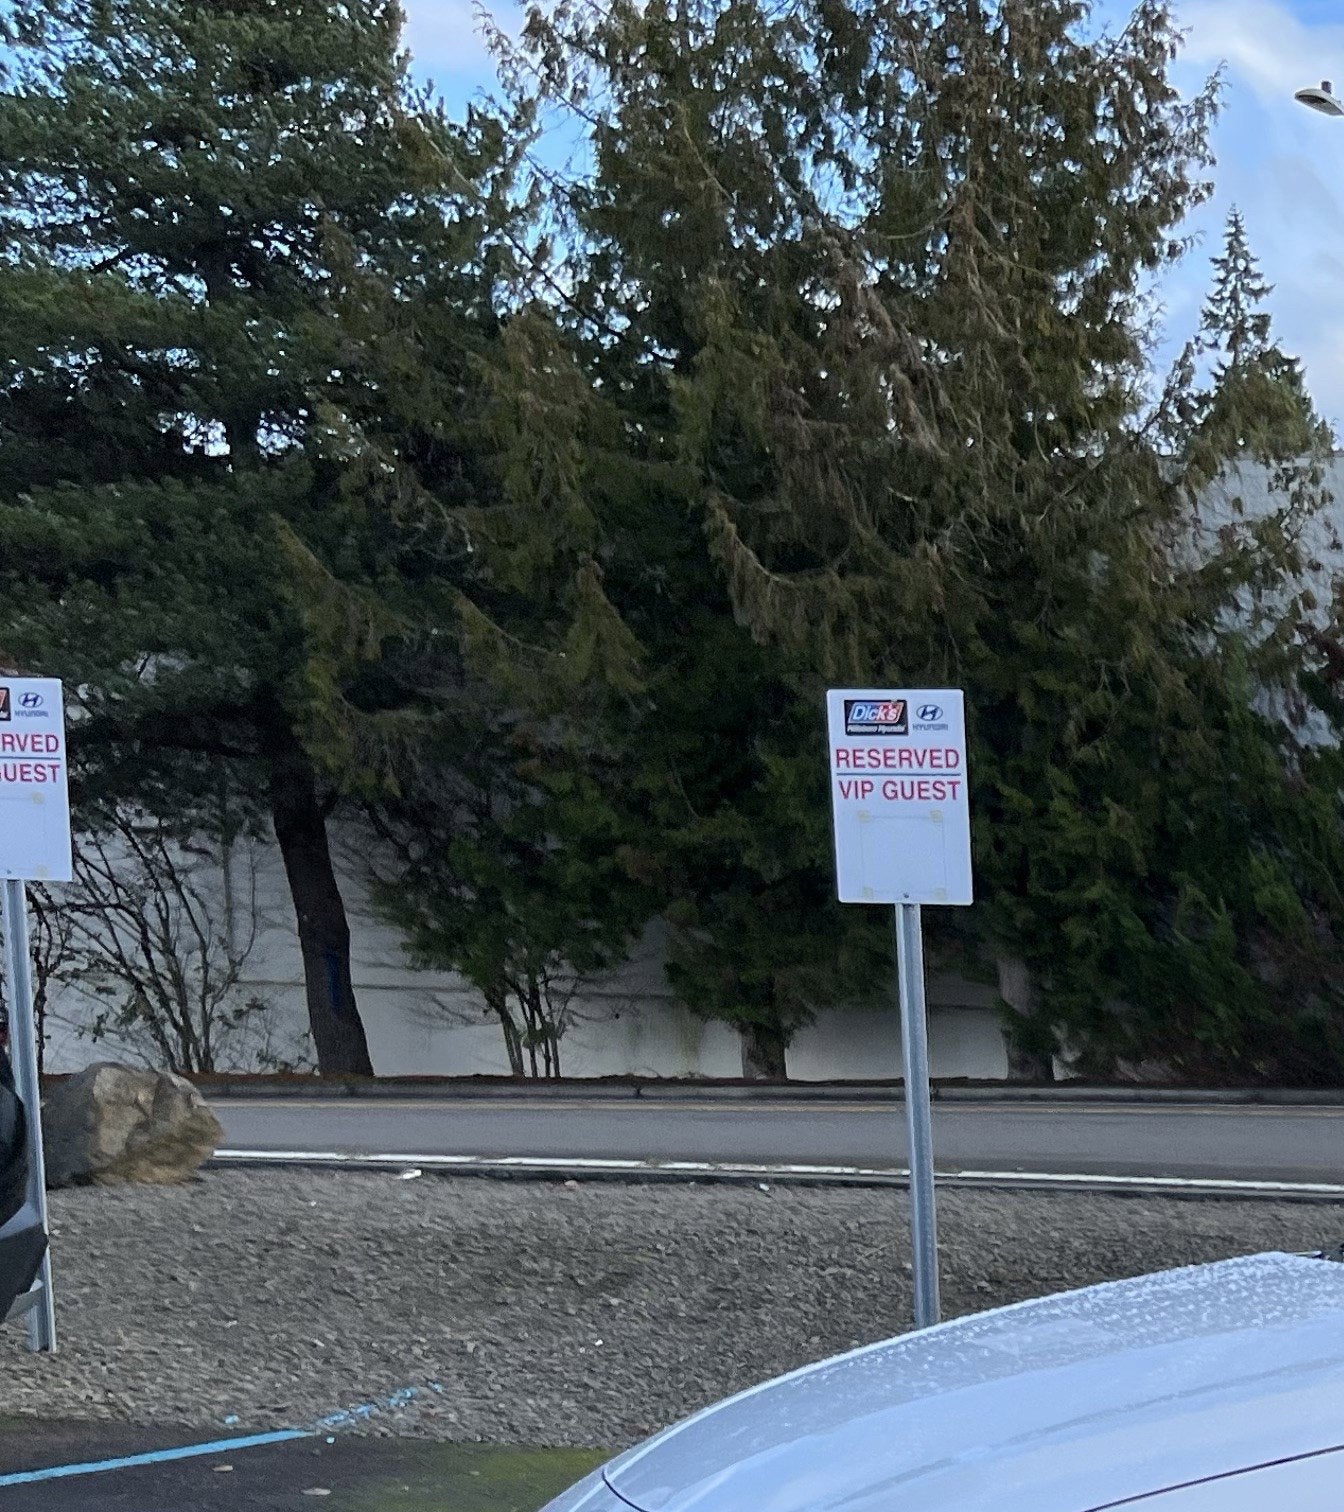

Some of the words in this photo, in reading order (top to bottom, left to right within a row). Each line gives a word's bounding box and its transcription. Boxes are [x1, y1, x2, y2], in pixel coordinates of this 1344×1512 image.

[0, 733, 60, 753] RVED
[835, 748, 960, 769] RESERVED
[0, 763, 61, 784] UEST
[838, 779, 875, 800] VIP
[882, 780, 962, 801] GUEST
